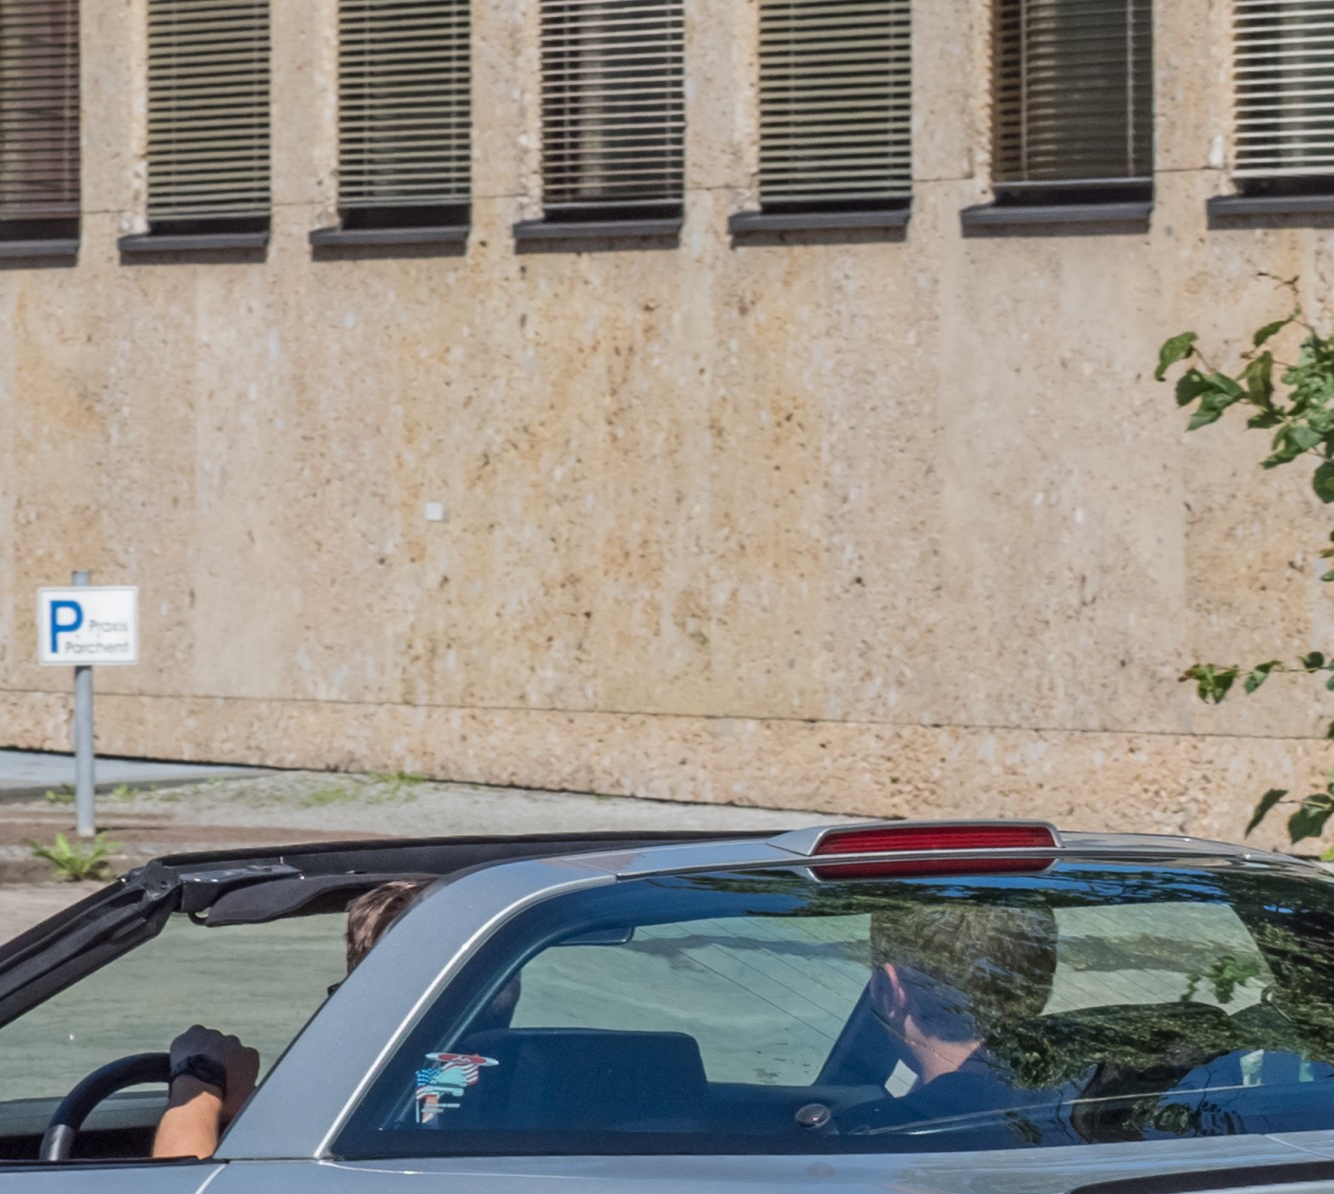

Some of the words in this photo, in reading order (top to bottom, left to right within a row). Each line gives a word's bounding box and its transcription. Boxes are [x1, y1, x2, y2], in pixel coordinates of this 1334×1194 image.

[50, 600, 83, 653] P
[89, 619, 128, 632] Praxis
[65, 641, 128, 654] Parchent
